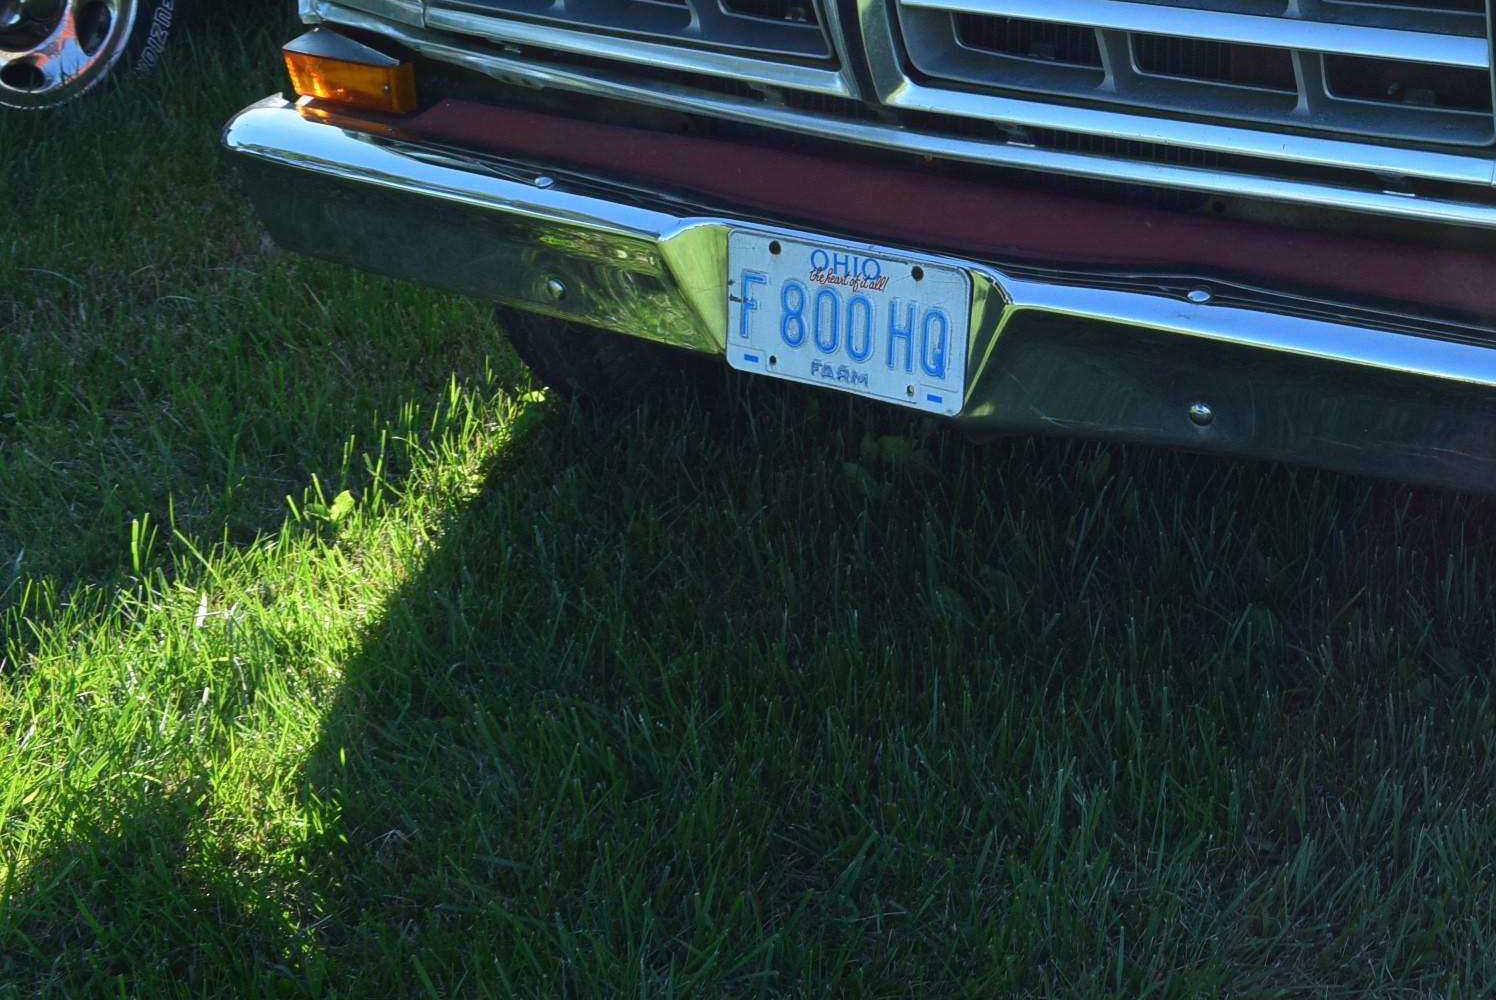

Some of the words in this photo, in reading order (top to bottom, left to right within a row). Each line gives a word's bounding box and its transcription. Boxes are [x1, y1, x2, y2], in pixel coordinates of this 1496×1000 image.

[810, 248, 881, 281] OHIO
[739, 268, 768, 339] F
[780, 279, 874, 362] 800
[887, 299, 950, 380] HQ
[810, 359, 870, 388] FARM
